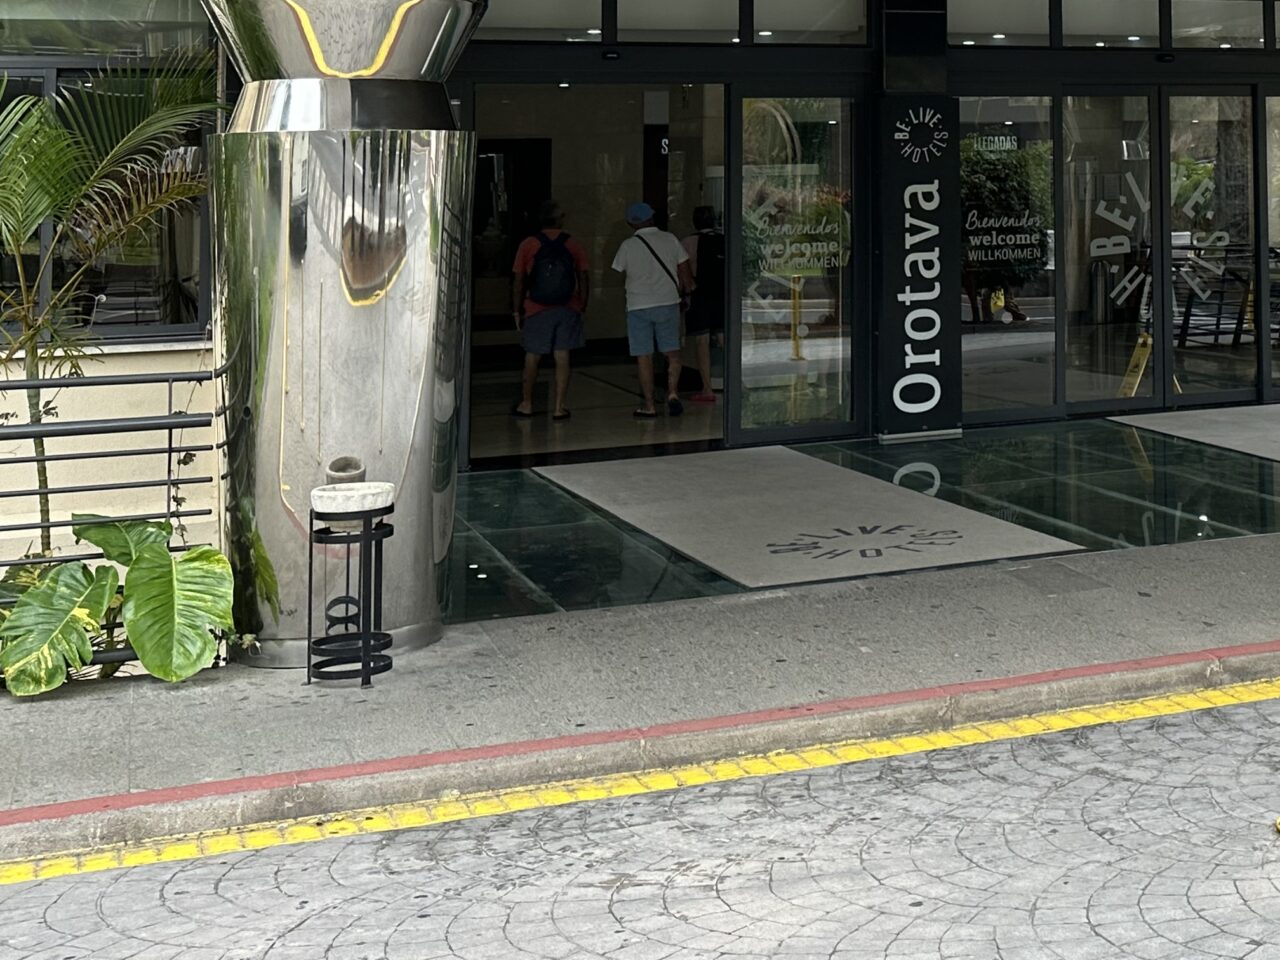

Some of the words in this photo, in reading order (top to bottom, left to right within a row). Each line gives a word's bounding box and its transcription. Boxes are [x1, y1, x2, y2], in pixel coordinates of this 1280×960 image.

[909, 107, 943, 128] LIVE
[894, 121, 911, 140] BE
[901, 131, 949, 164] HOTELS
[756, 216, 839, 238] Bienvenidos
[965, 209, 1041, 230] Bienvenidos
[1090, 200, 1137, 257] BE
[760, 239, 838, 255] welcome
[968, 230, 1040, 246] welcome
[967, 248, 1041, 262] WILLKOMMEN
[893, 178, 942, 414] Orotava
[798, 525, 915, 539] LIVE
